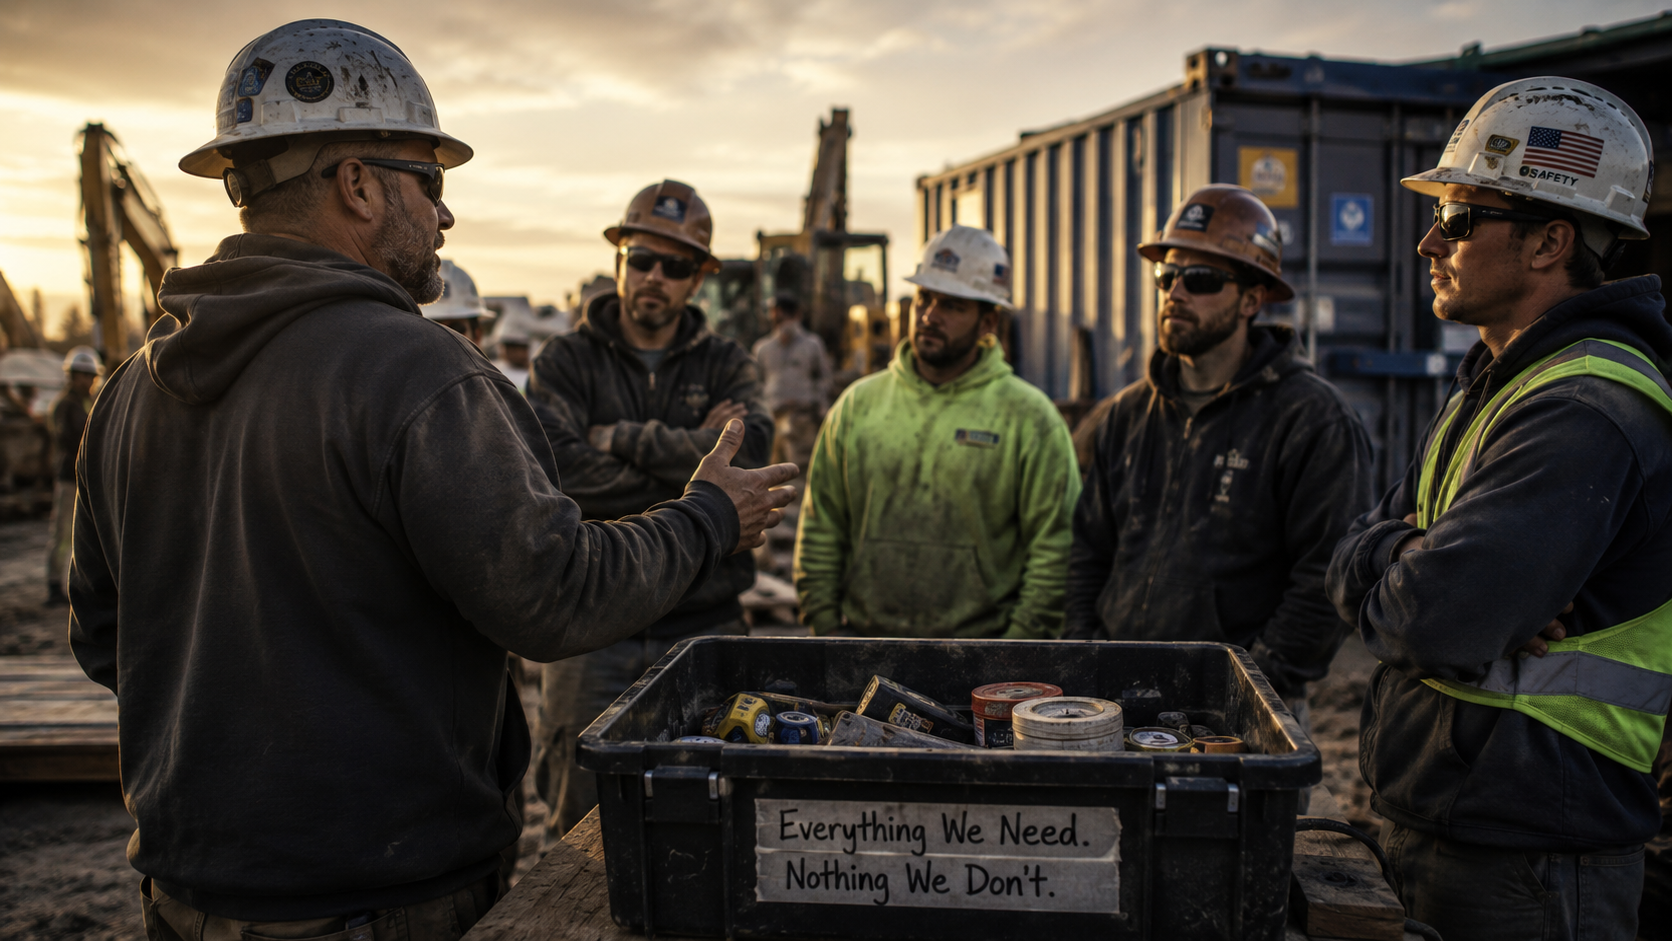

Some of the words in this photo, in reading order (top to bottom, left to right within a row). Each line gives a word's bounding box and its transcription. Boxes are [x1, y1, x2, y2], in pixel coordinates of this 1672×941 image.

[1529, 168, 1579, 186] SAFETY
[779, 808, 926, 857] Everything
[941, 810, 985, 845] We
[1000, 811, 1090, 847] Need.
[786, 857, 890, 906] Nothing
[905, 860, 951, 894] We
[965, 863, 1055, 898] Don't.
